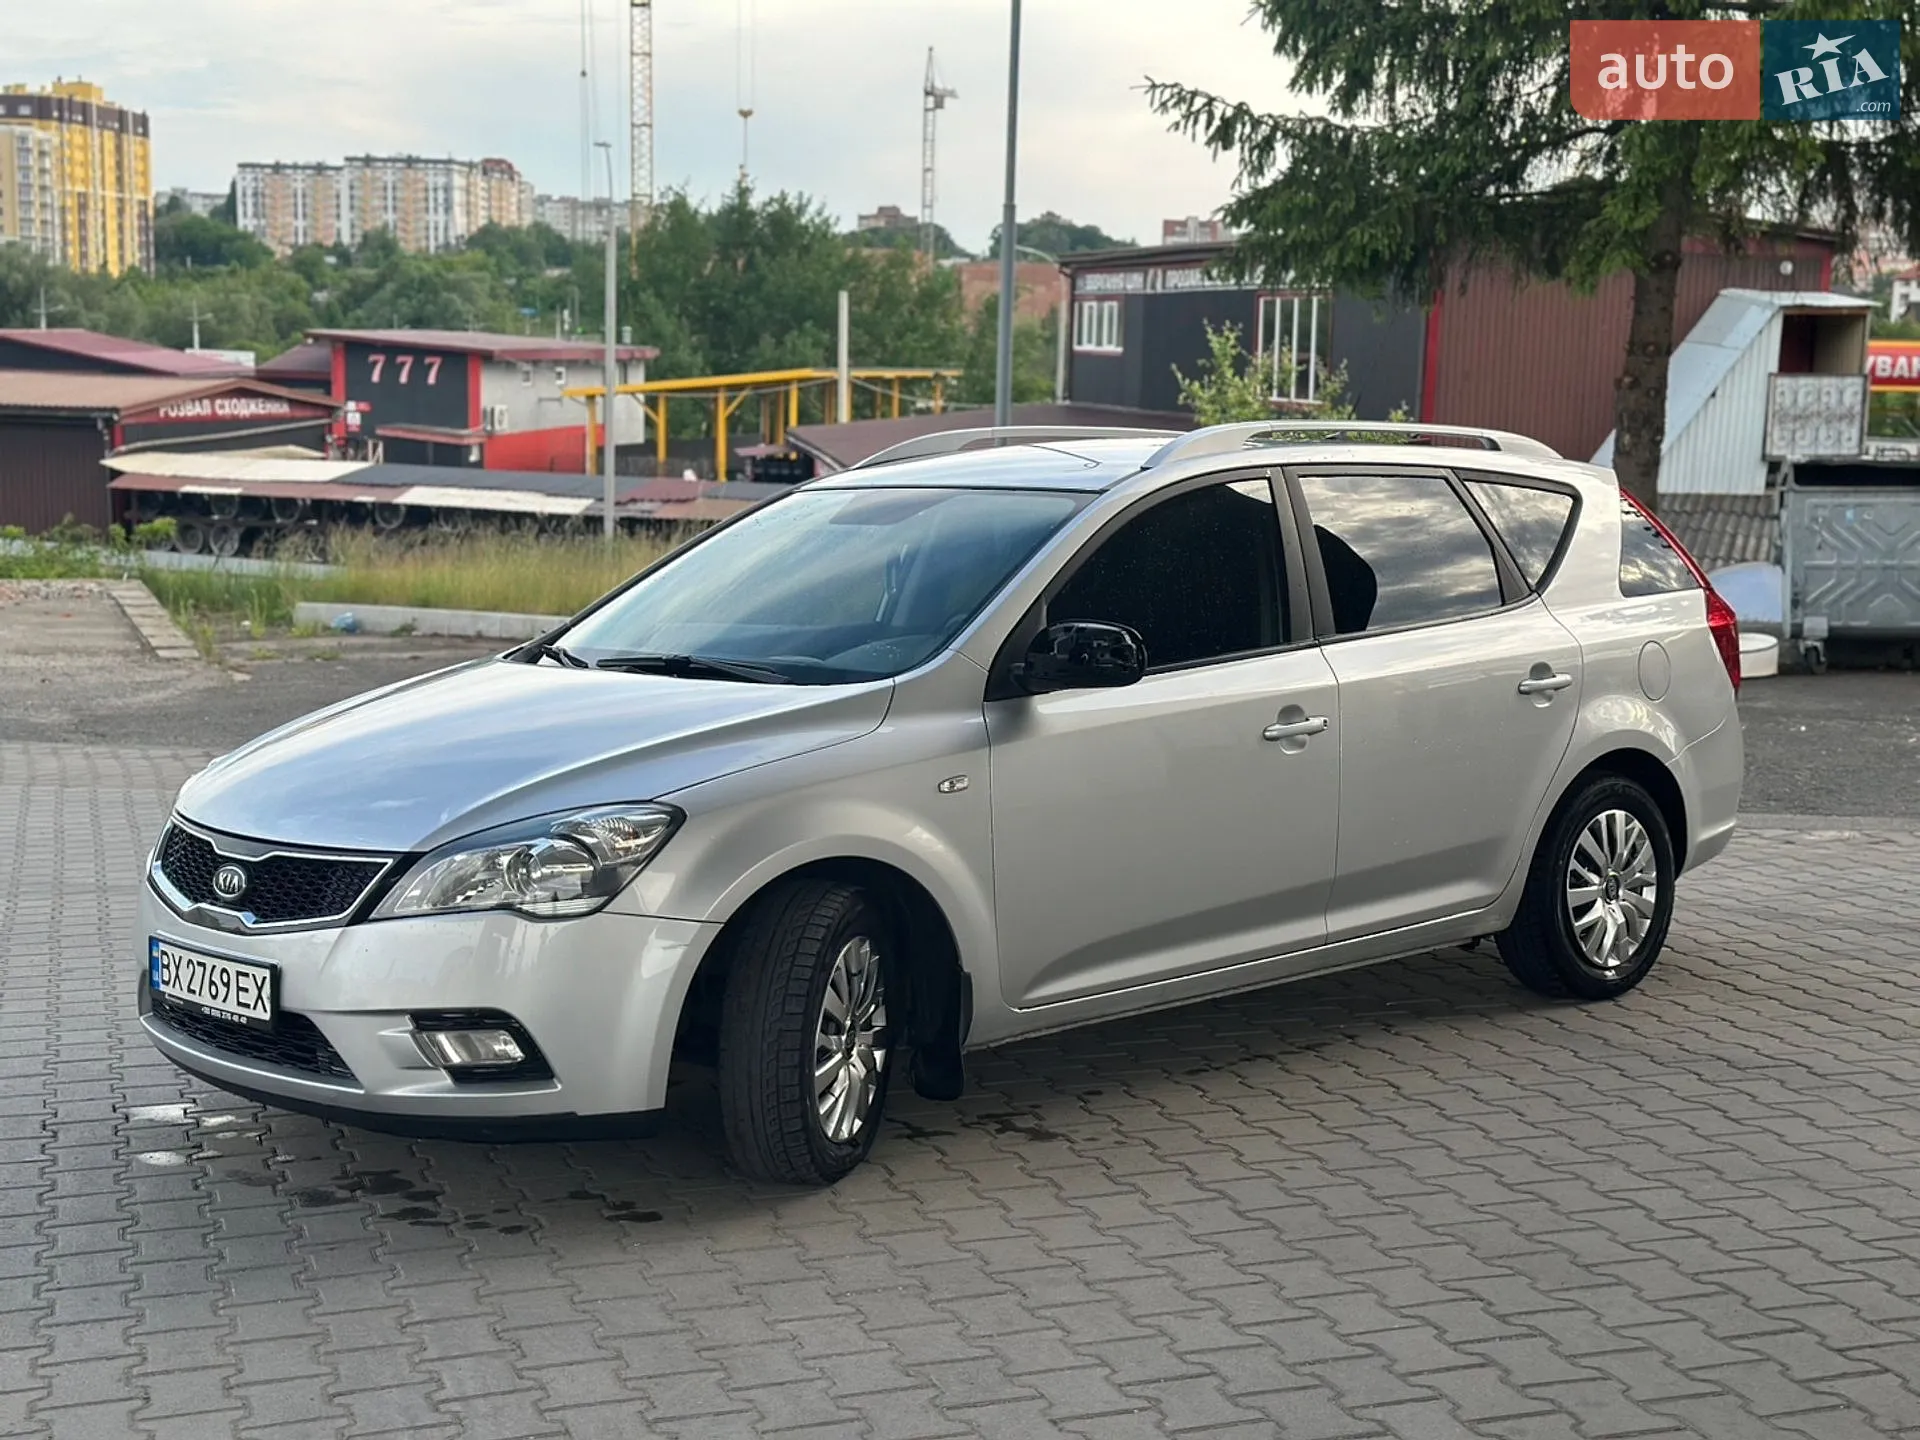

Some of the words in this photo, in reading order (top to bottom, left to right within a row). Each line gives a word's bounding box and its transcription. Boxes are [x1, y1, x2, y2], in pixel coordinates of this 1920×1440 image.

[368, 354, 443, 385] 777
[219, 872, 239, 892] KIA
[160, 949, 183, 991] BX
[186, 958, 231, 1003] 2769
[235, 969, 268, 1013] EX
